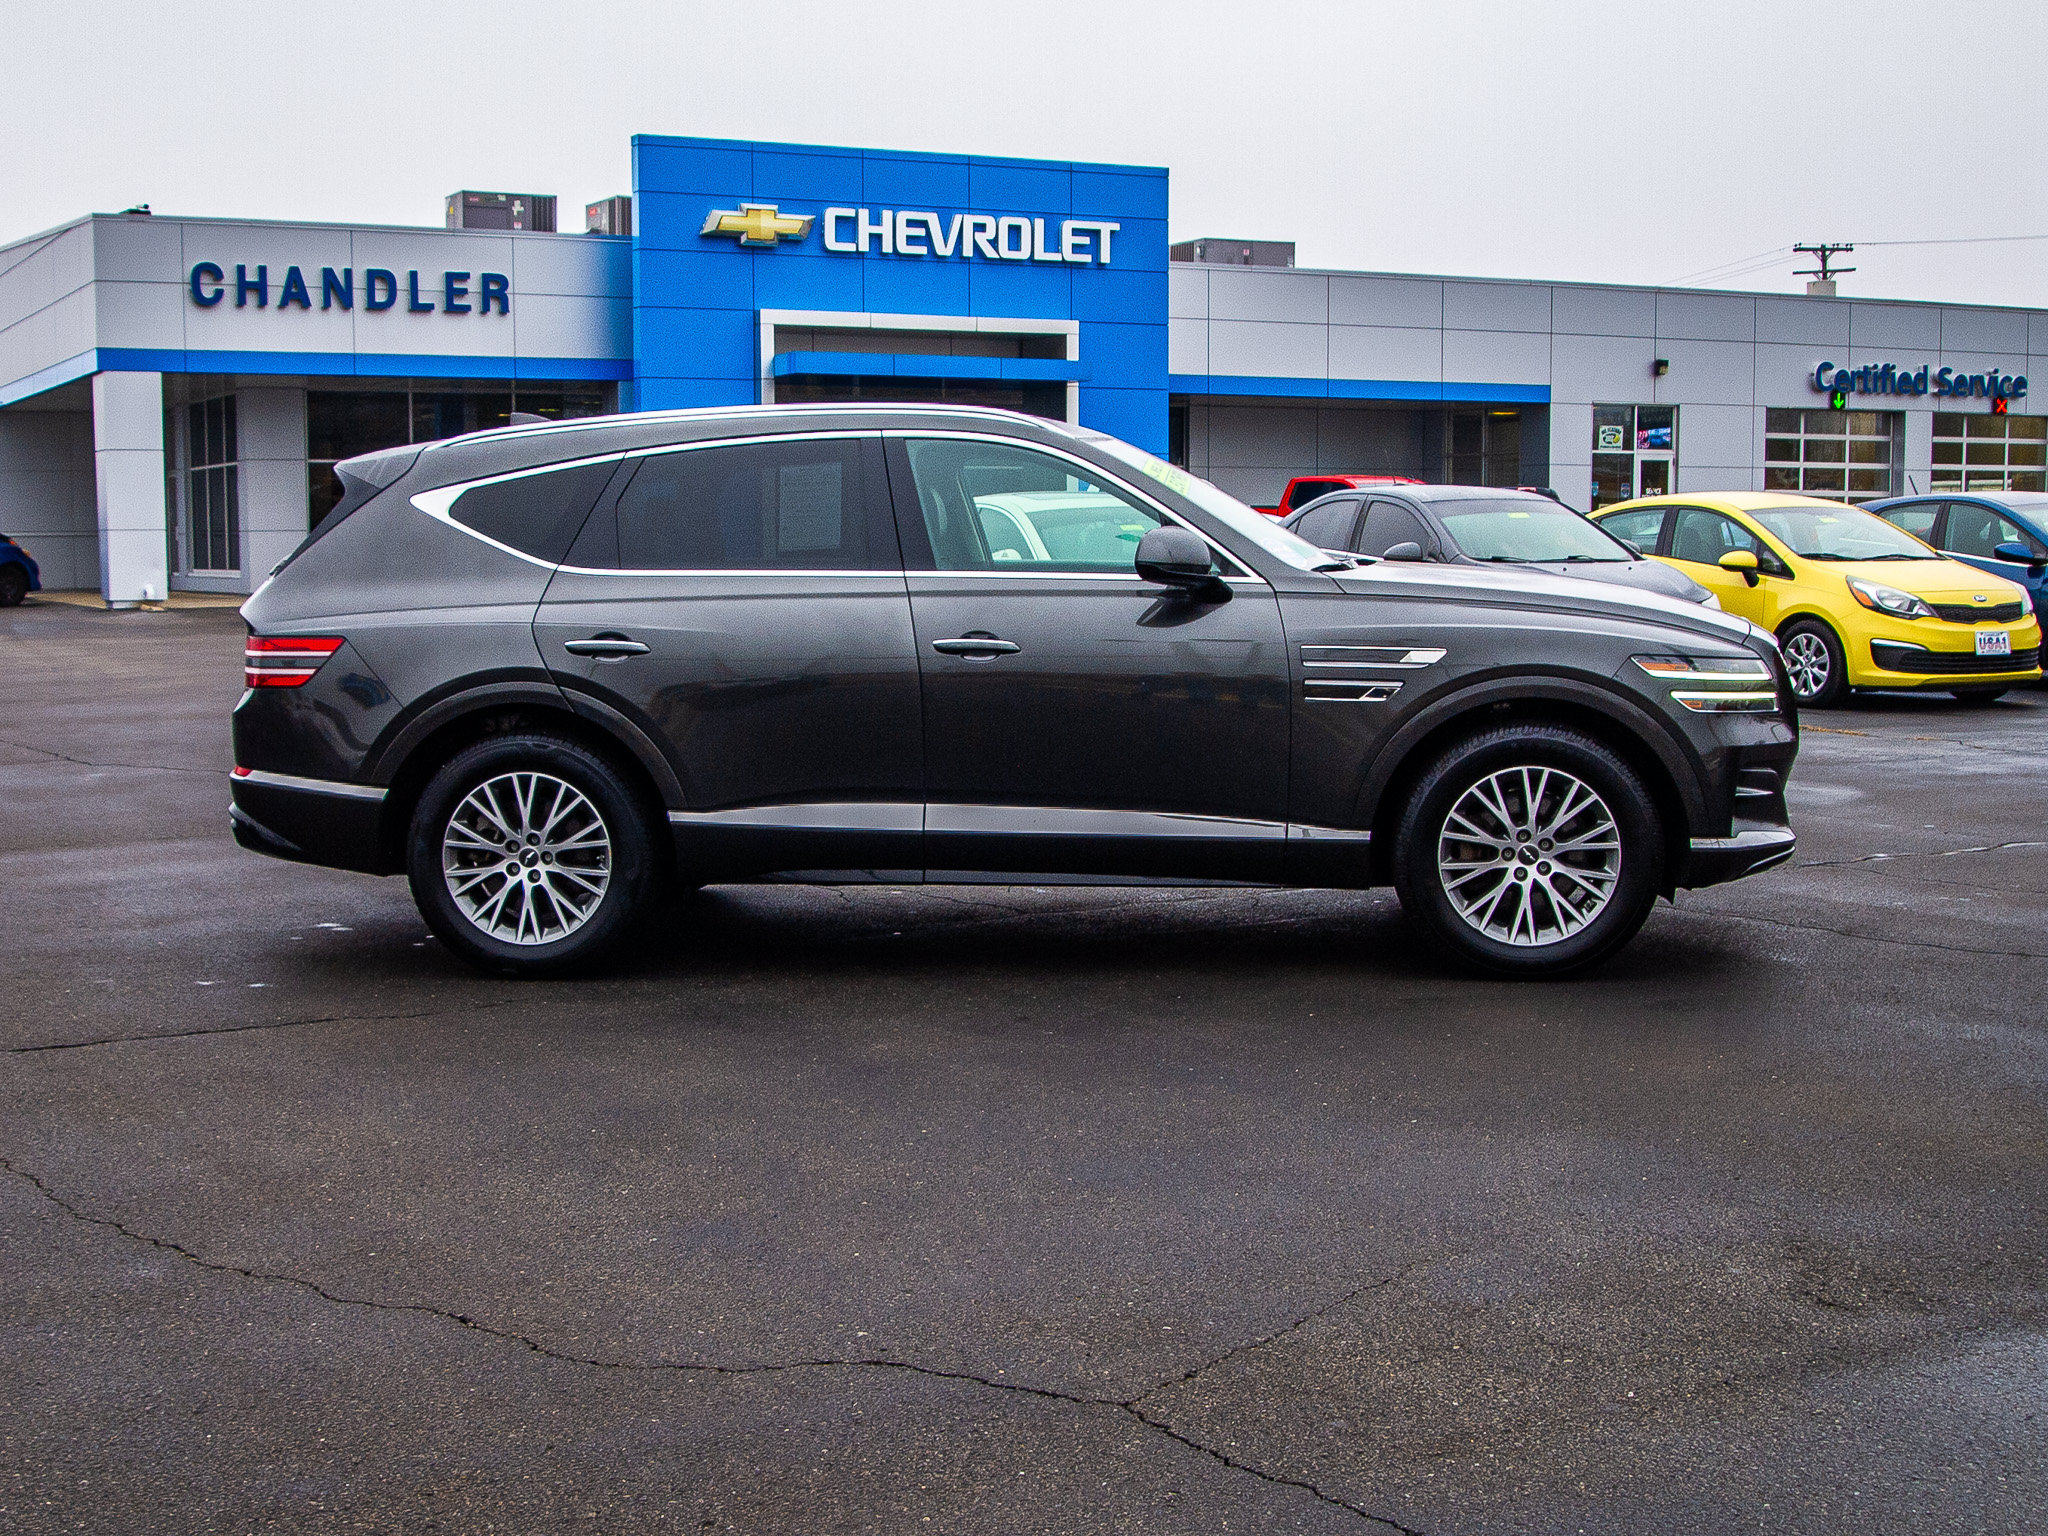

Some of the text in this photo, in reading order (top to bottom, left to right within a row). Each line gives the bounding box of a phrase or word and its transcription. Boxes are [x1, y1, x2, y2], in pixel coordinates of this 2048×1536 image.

[823, 206, 1120, 265] CHEVROLET
[190, 261, 511, 315] CHANDLER
[1815, 361, 2028, 398] Certified Service
[1978, 636, 2007, 650] USA1
